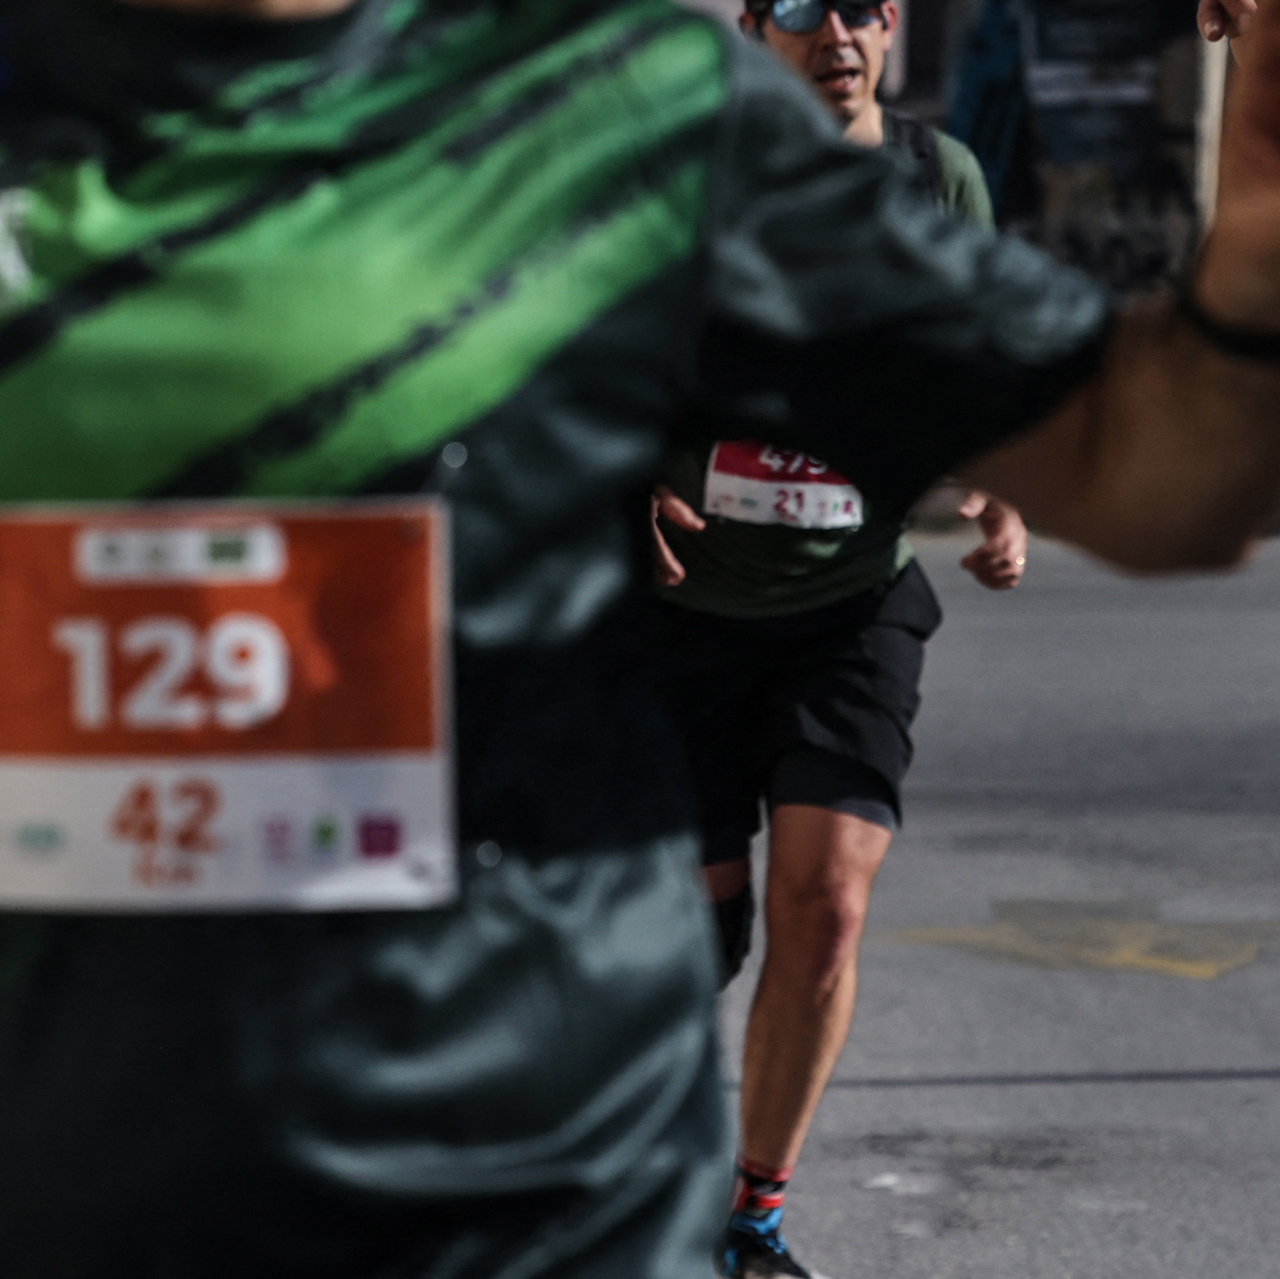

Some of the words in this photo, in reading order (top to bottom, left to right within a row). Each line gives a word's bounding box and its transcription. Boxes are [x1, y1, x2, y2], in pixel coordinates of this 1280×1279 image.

[774, 489, 806, 512] 21
[53, 612, 290, 730] 129
[111, 779, 221, 855] 42
